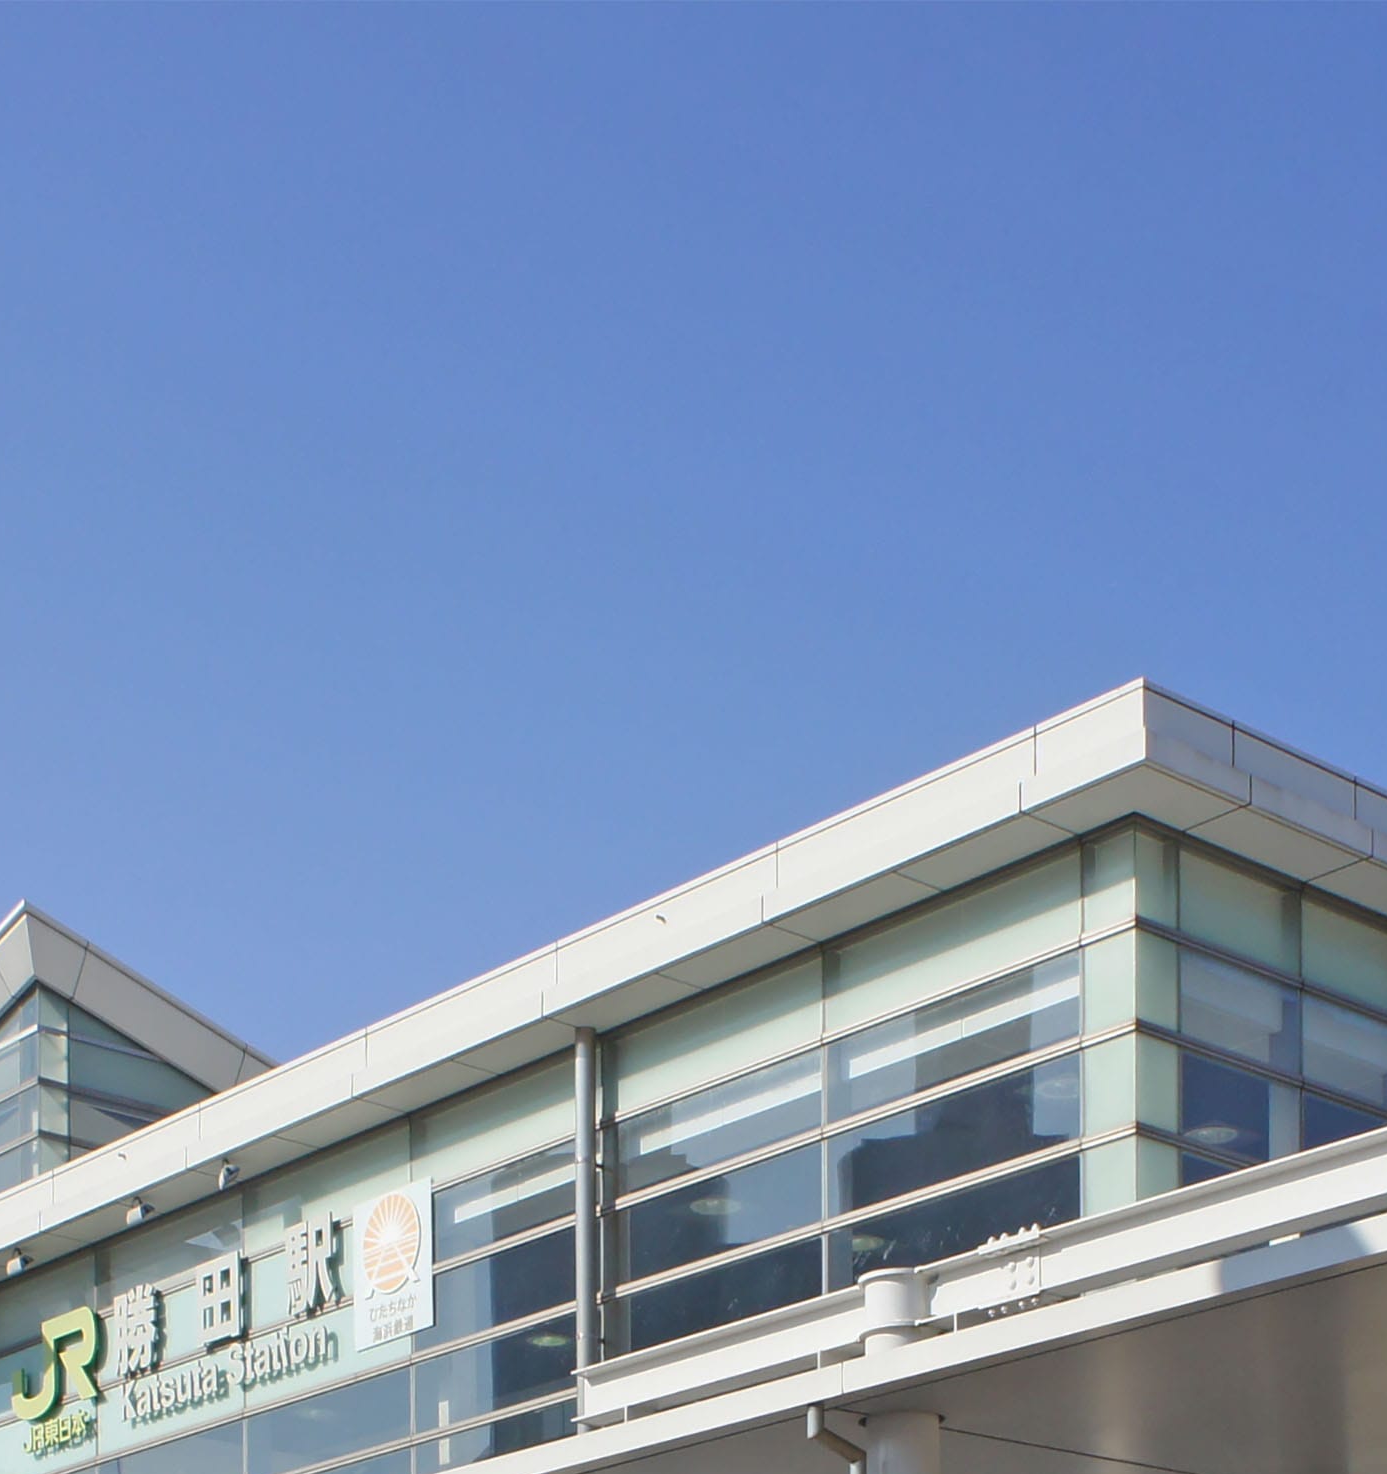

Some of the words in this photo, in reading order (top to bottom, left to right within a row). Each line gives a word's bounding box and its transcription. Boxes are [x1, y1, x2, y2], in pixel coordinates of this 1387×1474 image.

[115, 1212, 337, 1376] 勝田駅
[12, 1306, 96, 1420] JR
[120, 1360, 217, 1421] Katsuta
[227, 1324, 329, 1385] Station
[24, 1409, 89, 1453] JR東日本
